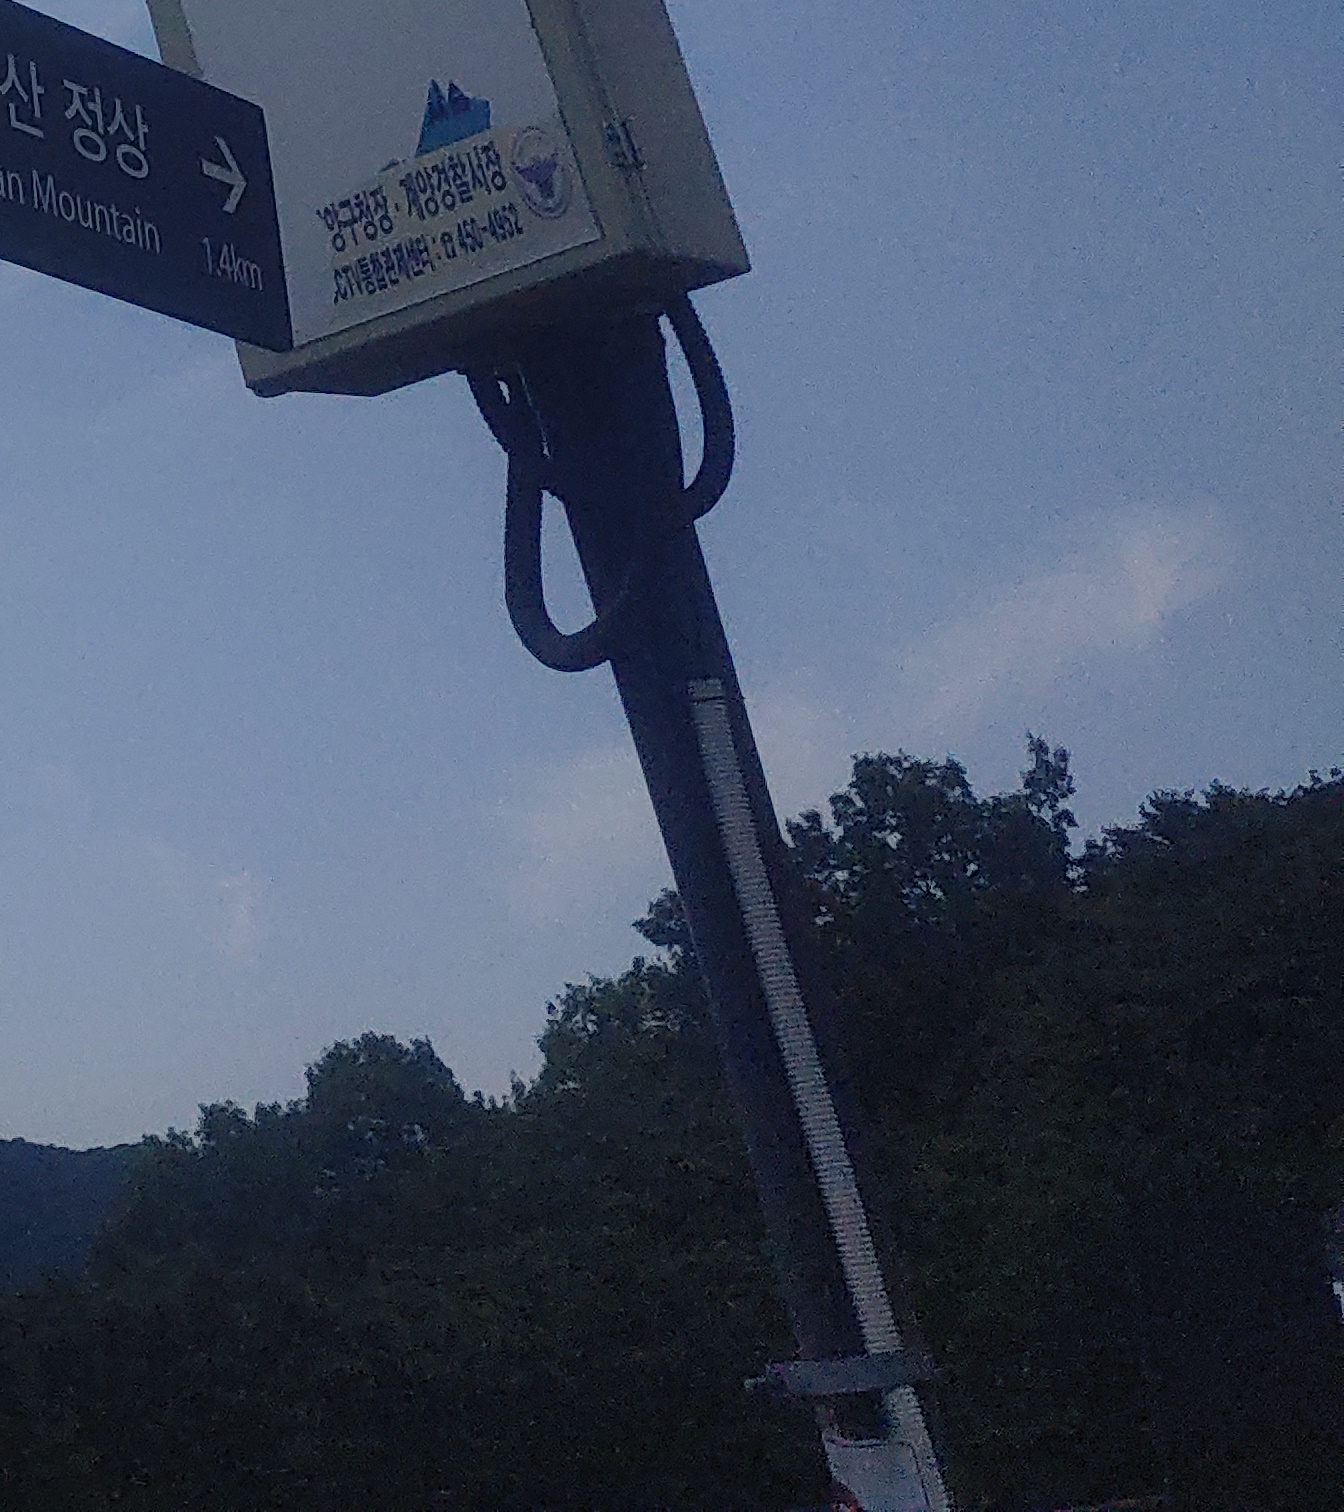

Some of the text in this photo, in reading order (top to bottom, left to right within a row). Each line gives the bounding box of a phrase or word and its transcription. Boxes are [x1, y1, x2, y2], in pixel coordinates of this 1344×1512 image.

[63, 78, 150, 179] 정상
[30, 168, 163, 255] Mountain
[201, 236, 265, 291] 1.4km
